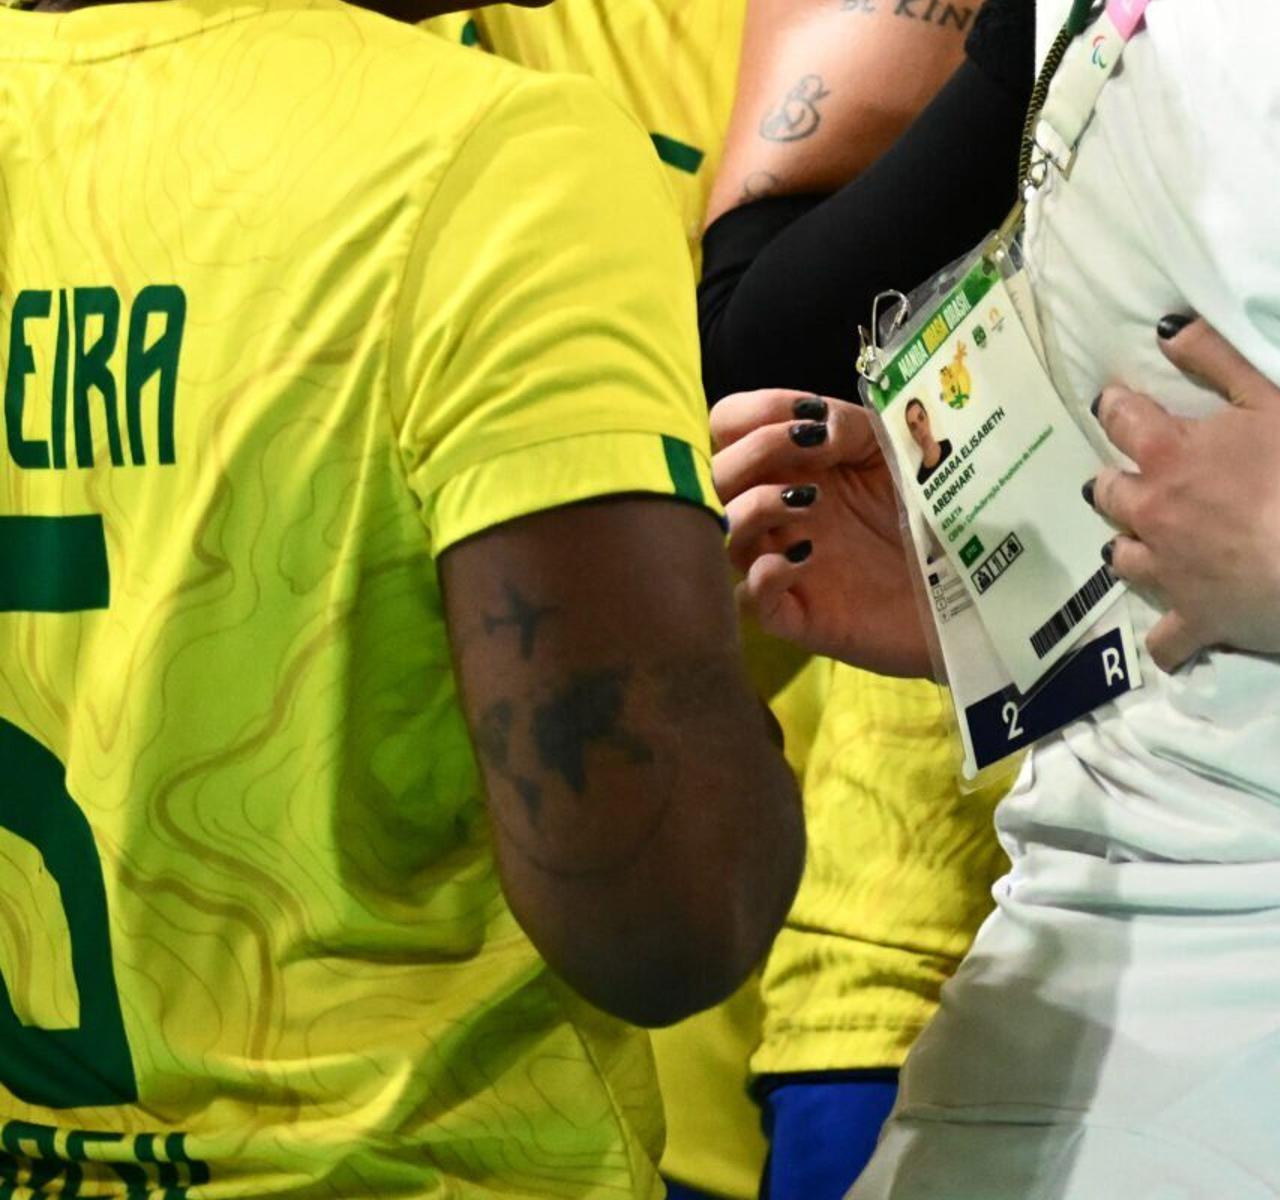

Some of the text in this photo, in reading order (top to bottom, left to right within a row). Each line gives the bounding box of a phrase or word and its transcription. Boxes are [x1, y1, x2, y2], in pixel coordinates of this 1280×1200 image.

[4, 284, 187, 469] EIRA
[923, 406, 1006, 500] BARBARA ELISABETH
[931, 463, 977, 516] ARENHART
[1002, 647, 1125, 741] 2 R
